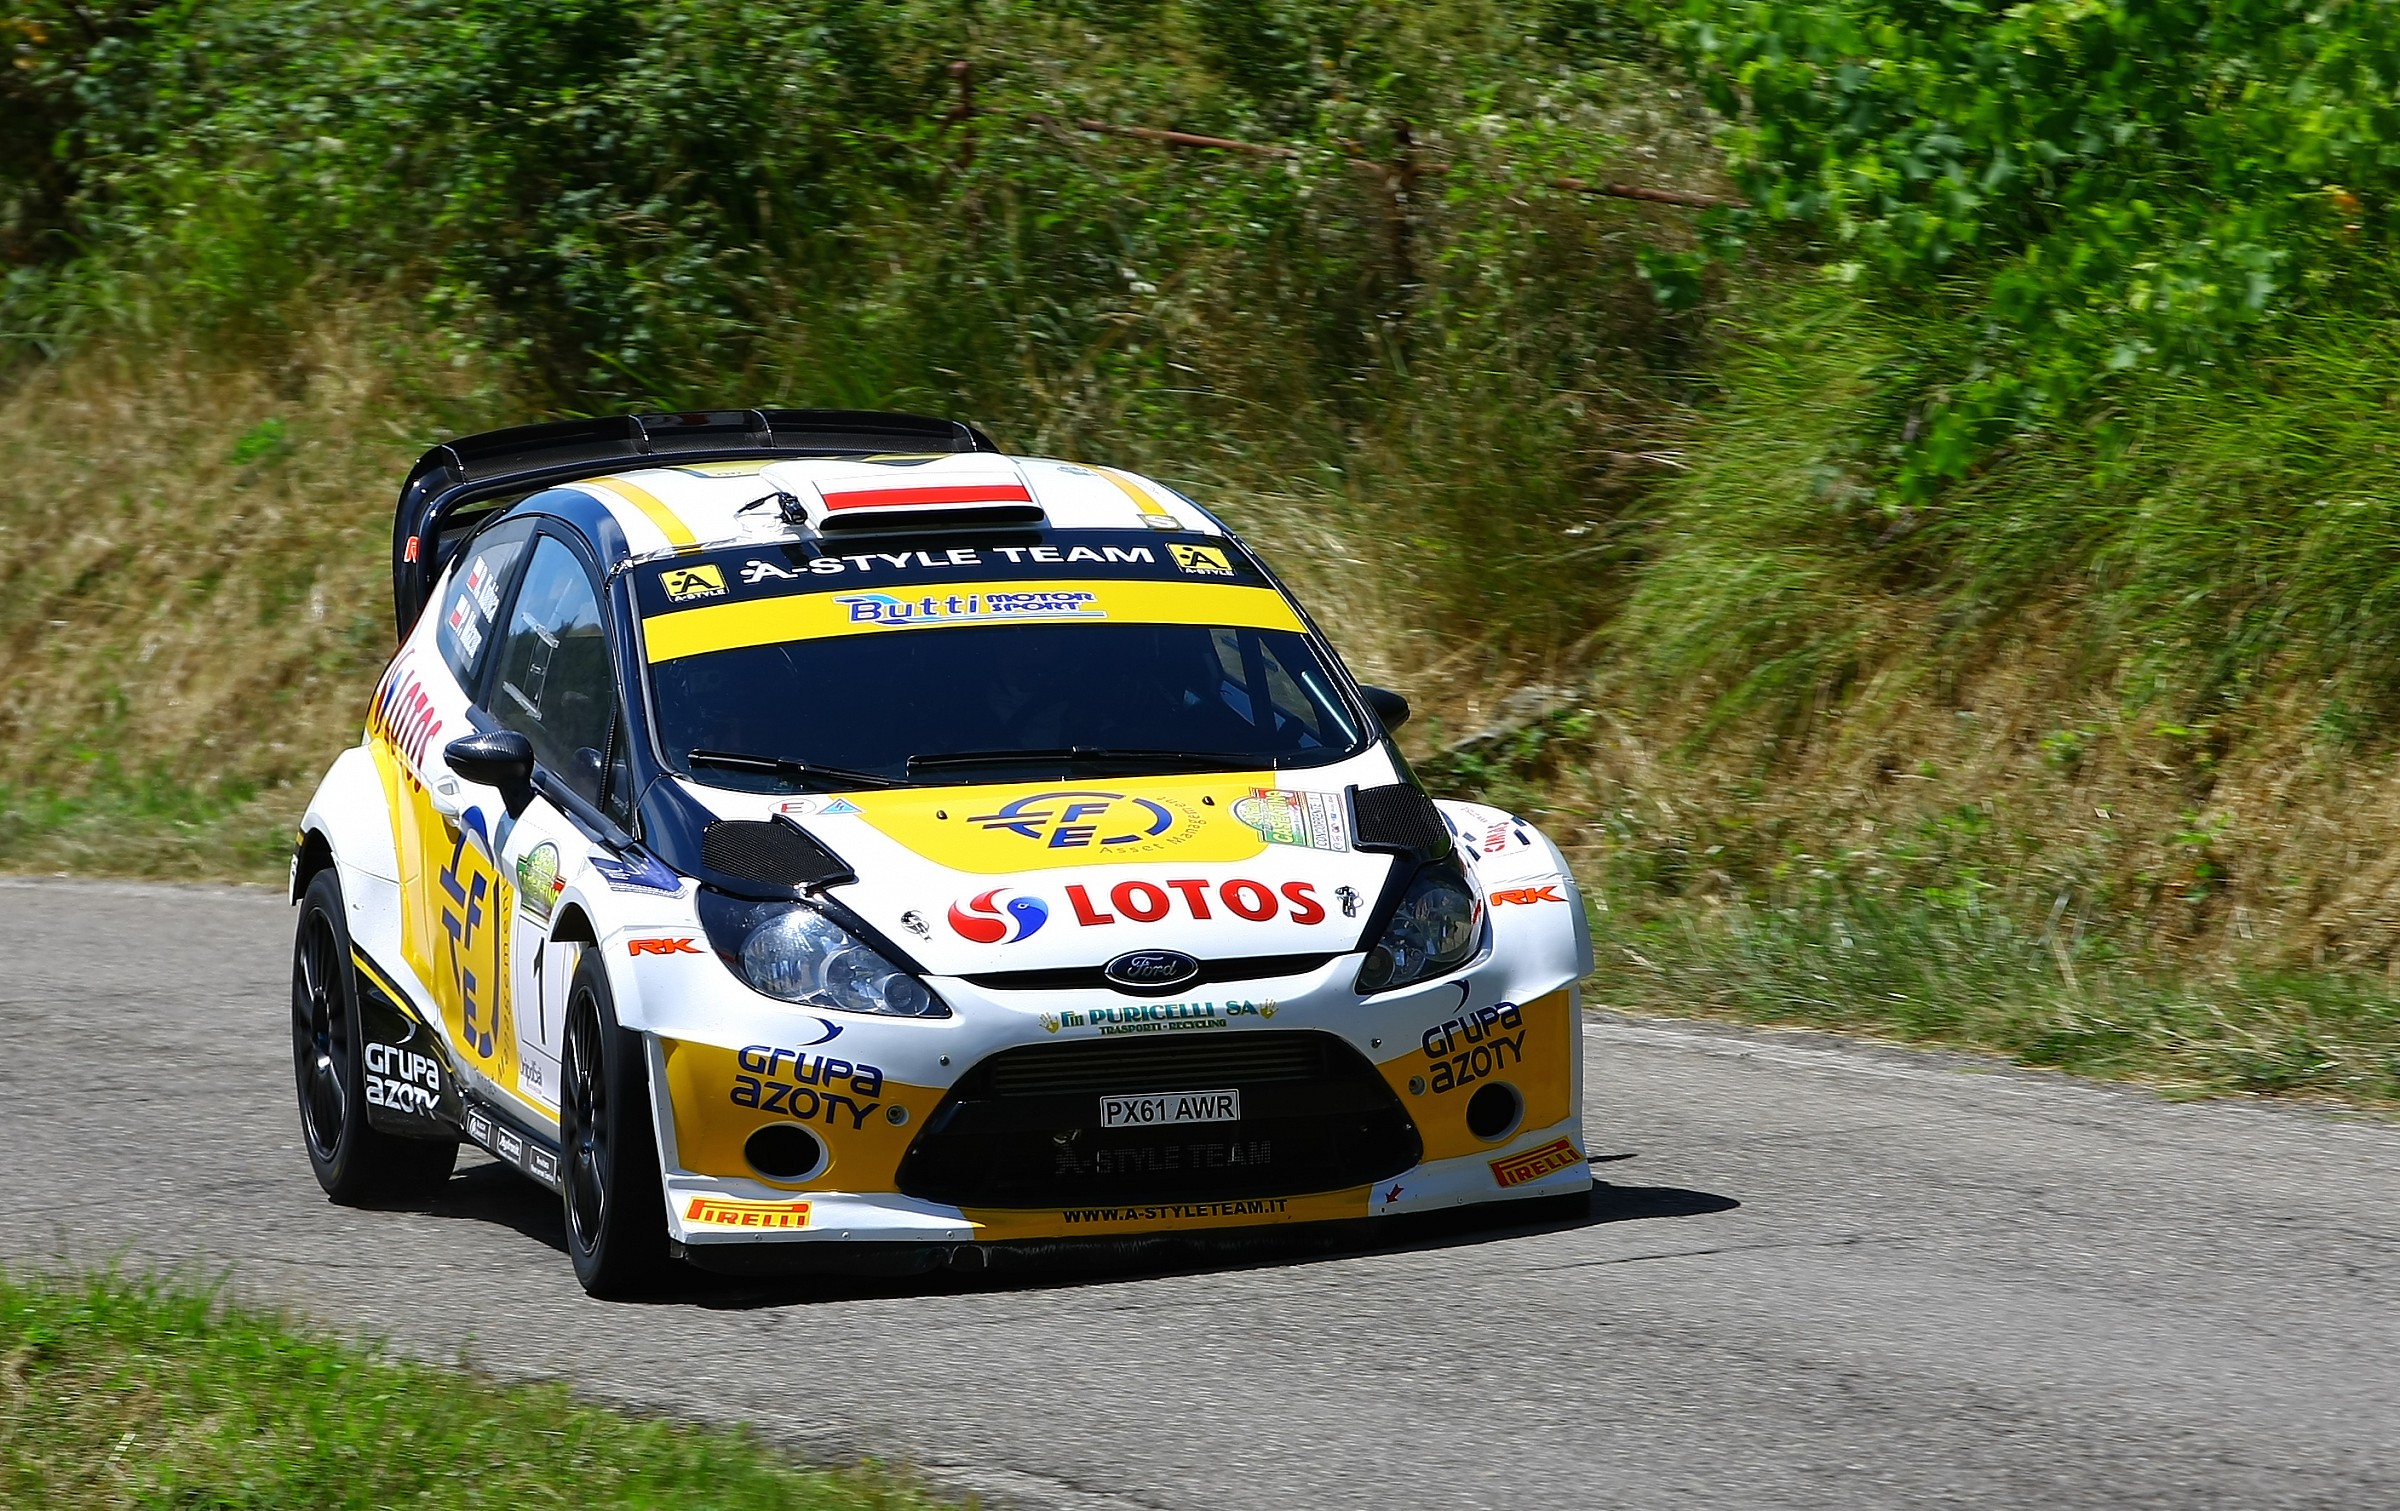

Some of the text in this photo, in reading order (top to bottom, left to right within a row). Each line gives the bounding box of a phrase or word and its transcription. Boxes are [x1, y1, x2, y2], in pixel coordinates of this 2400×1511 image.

[740, 546, 1156, 584] A-STYLE TEAM
[674, 588, 727, 603] A-STYLE
[986, 592, 1094, 603] MOTOR
[992, 601, 1080, 611] SPORT
[851, 596, 978, 622] Butti
[1099, 843, 1166, 855] Asset
[1165, 796, 1208, 846] Management
[1065, 878, 1326, 927] LOTOS
[1490, 885, 1568, 907] RK
[628, 937, 707, 957] RK
[1127, 955, 1178, 978] Ford
[532, 936, 547, 1047] 1
[1088, 1002, 1215, 1026] PURICELLI
[1225, 1000, 1259, 1016] SA
[1106, 1096, 1234, 1124] PX61 AWR
[1187, 1140, 1272, 1168] TEAM
[1491, 1138, 1581, 1188] PIRELLI
[687, 1199, 810, 1228] PIRELLI
[1063, 1198, 1288, 1224] WWW.A-STYLETEAM.IT
